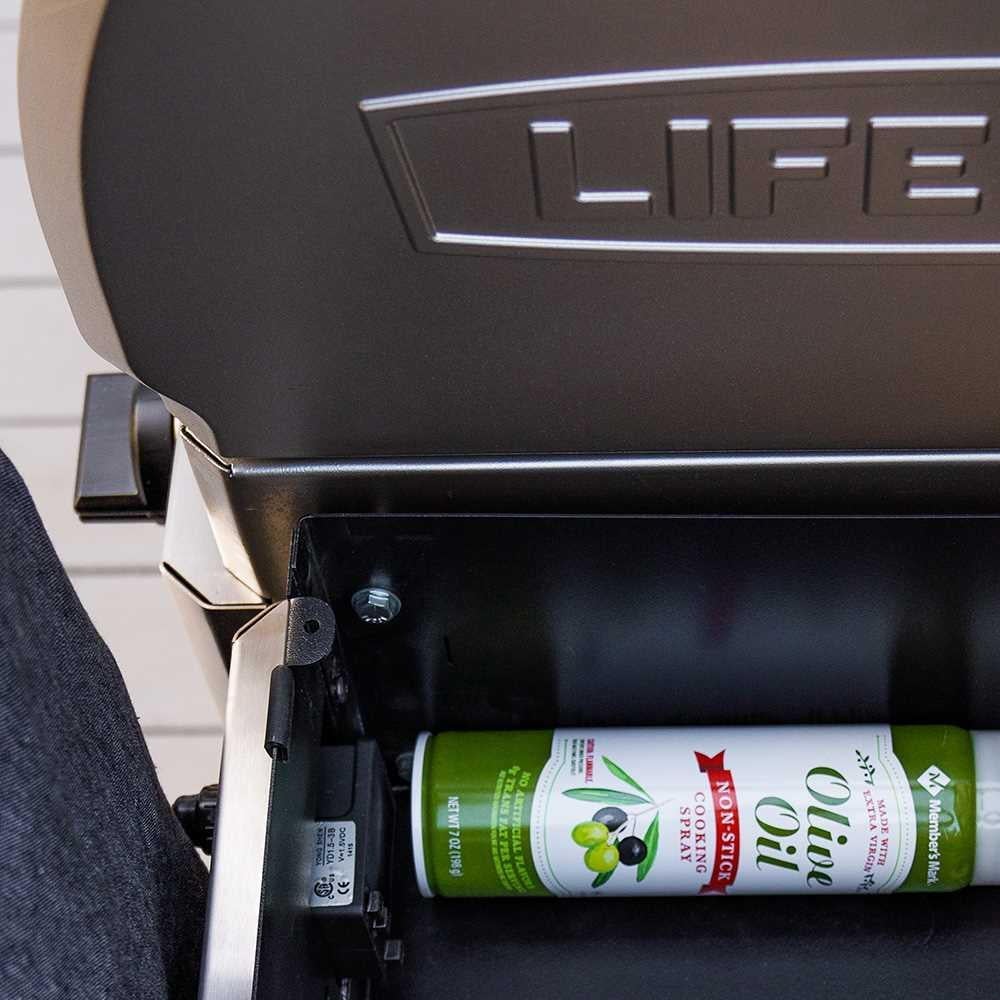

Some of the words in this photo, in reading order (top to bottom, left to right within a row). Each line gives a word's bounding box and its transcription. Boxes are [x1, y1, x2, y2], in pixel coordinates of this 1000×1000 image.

[500, 778, 516, 814] TRANS
[519, 771, 531, 787] NO
[447, 796, 460, 812] NET
[447, 814, 460, 829] WT
[512, 789, 524, 853] ARTIFICIAL
[863, 790, 878, 830] EXTRA
[877, 800, 889, 834] MADE
[449, 838, 461, 850] OZ
[498, 818, 510, 839] FAT
[680, 806, 692, 863] SPRAY
[695, 792, 707, 874] COOKING
[716, 781, 736, 881] NON-STICK
[755, 796, 800, 871] Oil
[805, 767, 852, 888] Olive
[928, 800, 942, 860] Member's
[500, 841, 511, 861] PER
[863, 836, 878, 873] VIRGIN
[877, 838, 889, 866] WITH
[337, 881, 350, 895] CE
